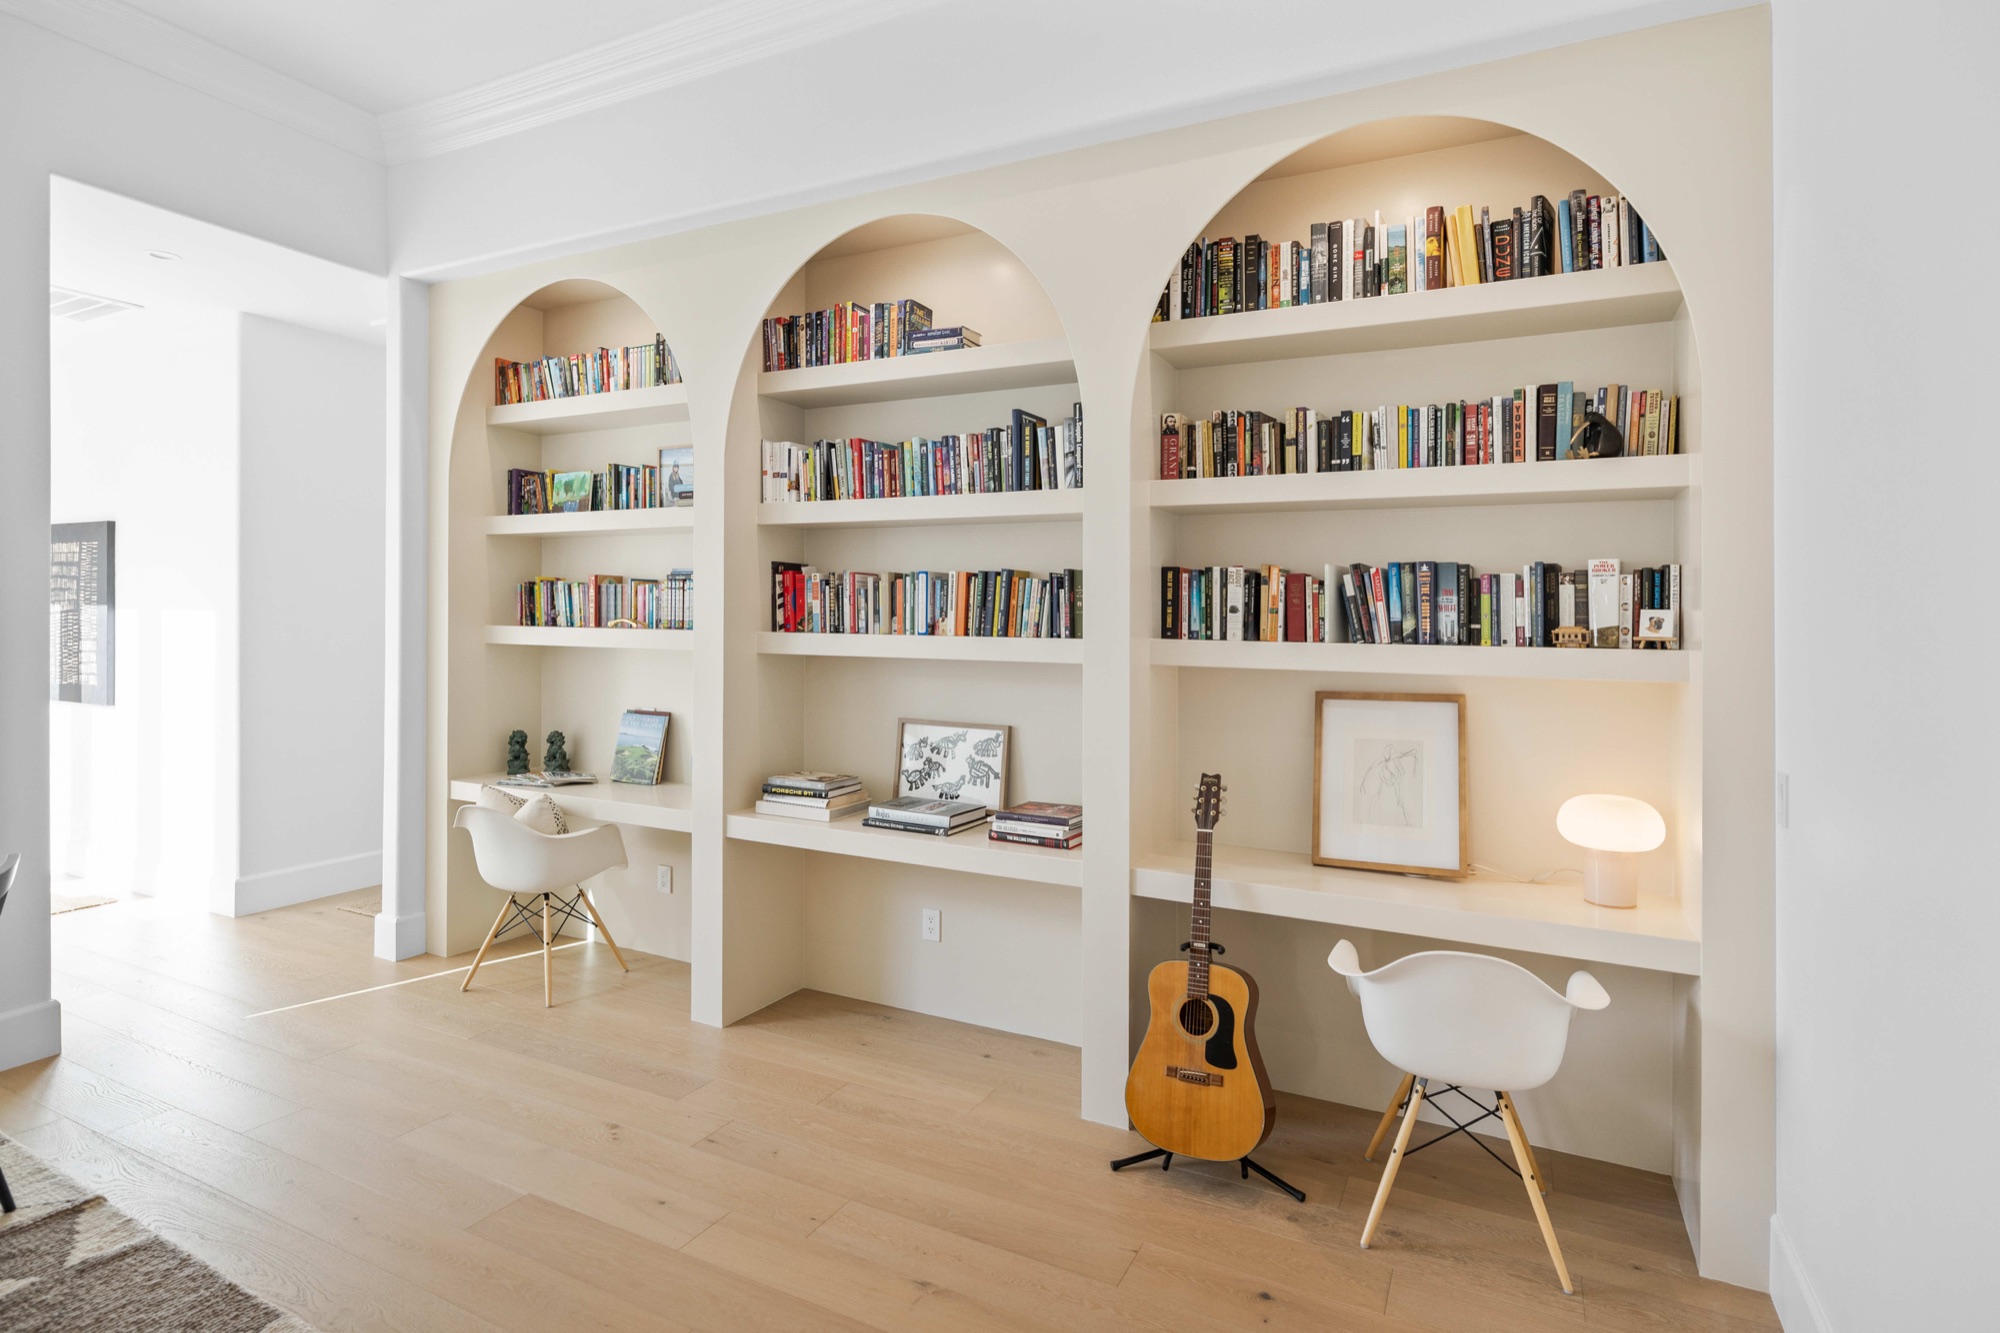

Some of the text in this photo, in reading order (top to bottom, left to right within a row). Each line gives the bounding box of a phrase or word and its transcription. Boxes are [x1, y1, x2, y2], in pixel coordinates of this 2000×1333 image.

[1577, 212, 1585, 231] allman
[1495, 235, 1511, 277] DUNE
[913, 305, 925, 317] TIME
[1169, 438, 1177, 476] GRANT
[771, 787, 802, 796] PORSCHE
